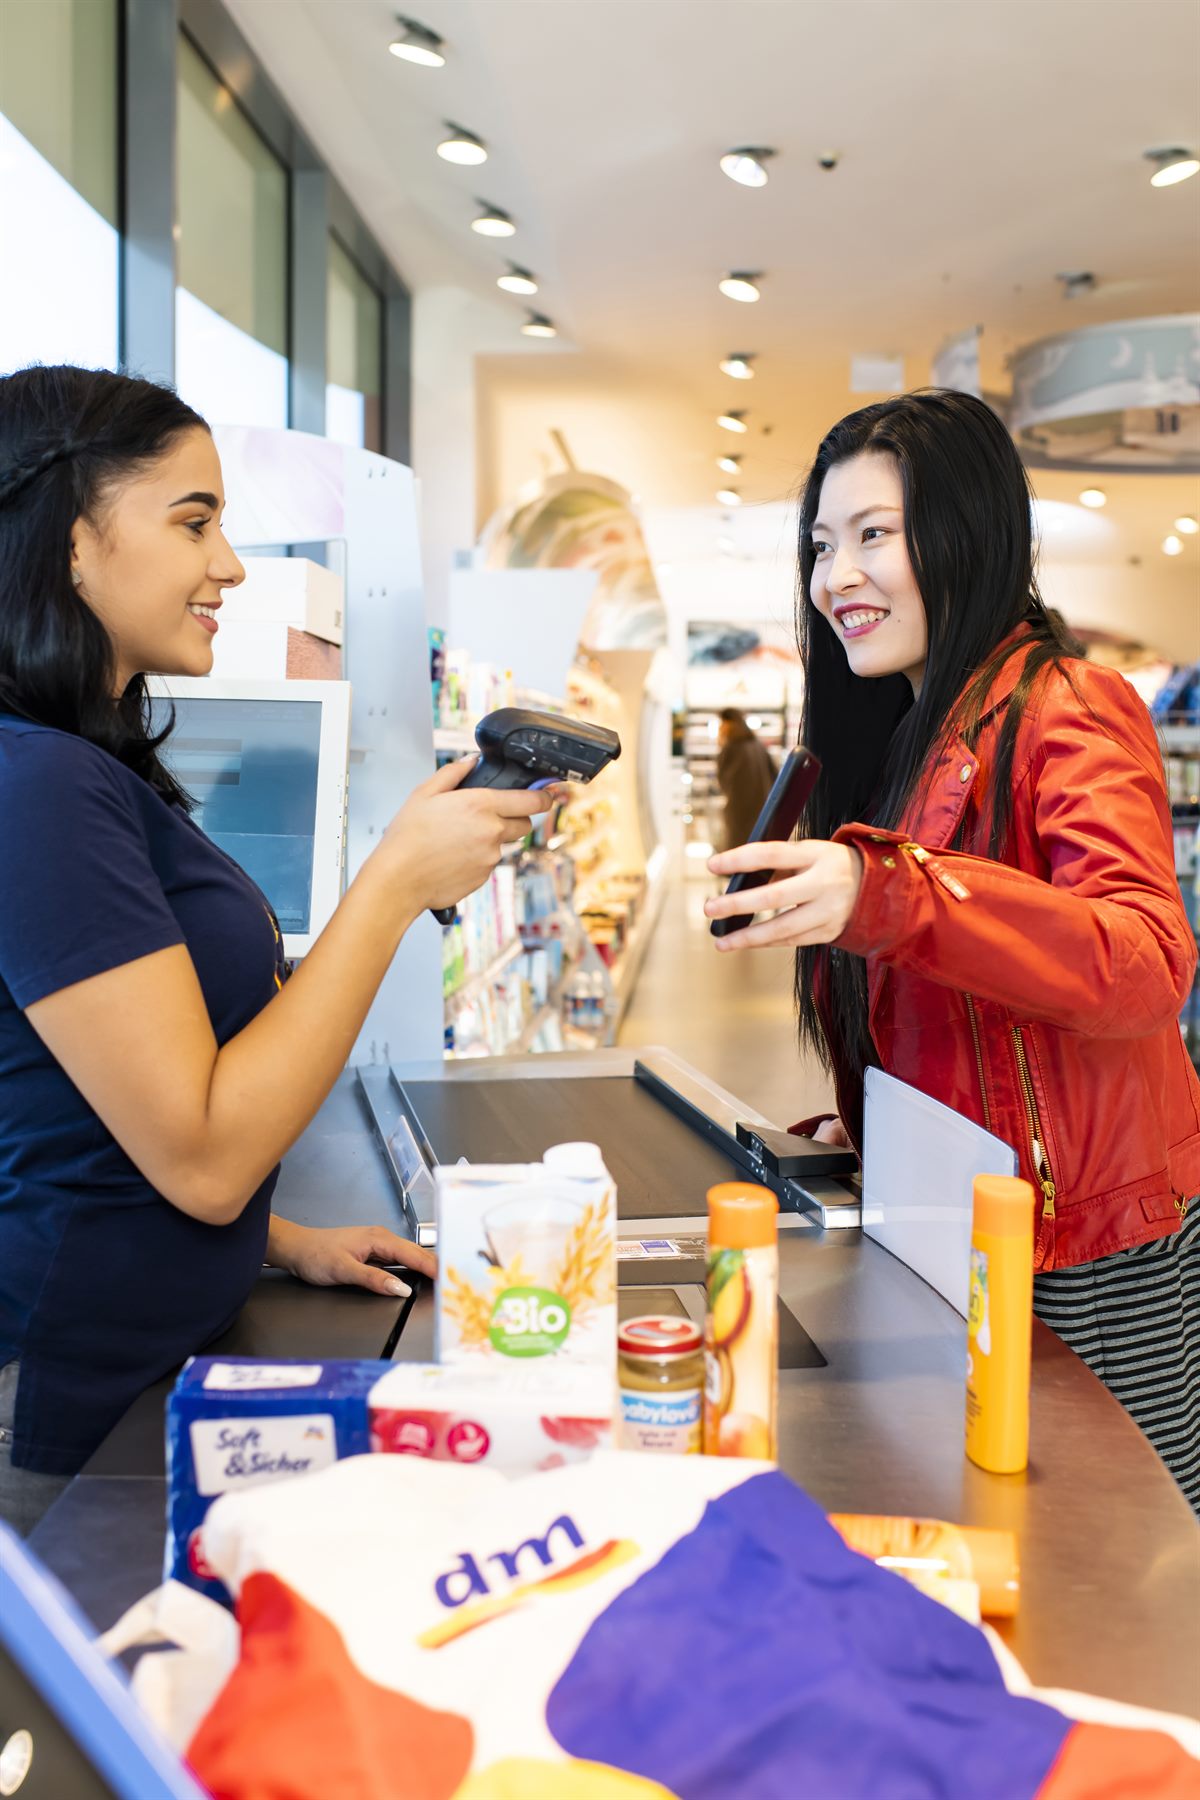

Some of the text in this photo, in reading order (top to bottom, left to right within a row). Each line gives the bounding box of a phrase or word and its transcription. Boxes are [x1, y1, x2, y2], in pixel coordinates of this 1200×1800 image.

[502, 1296, 567, 1334] Bio
[216, 1427, 260, 1451] Soft
[435, 1515, 585, 1607] dm
